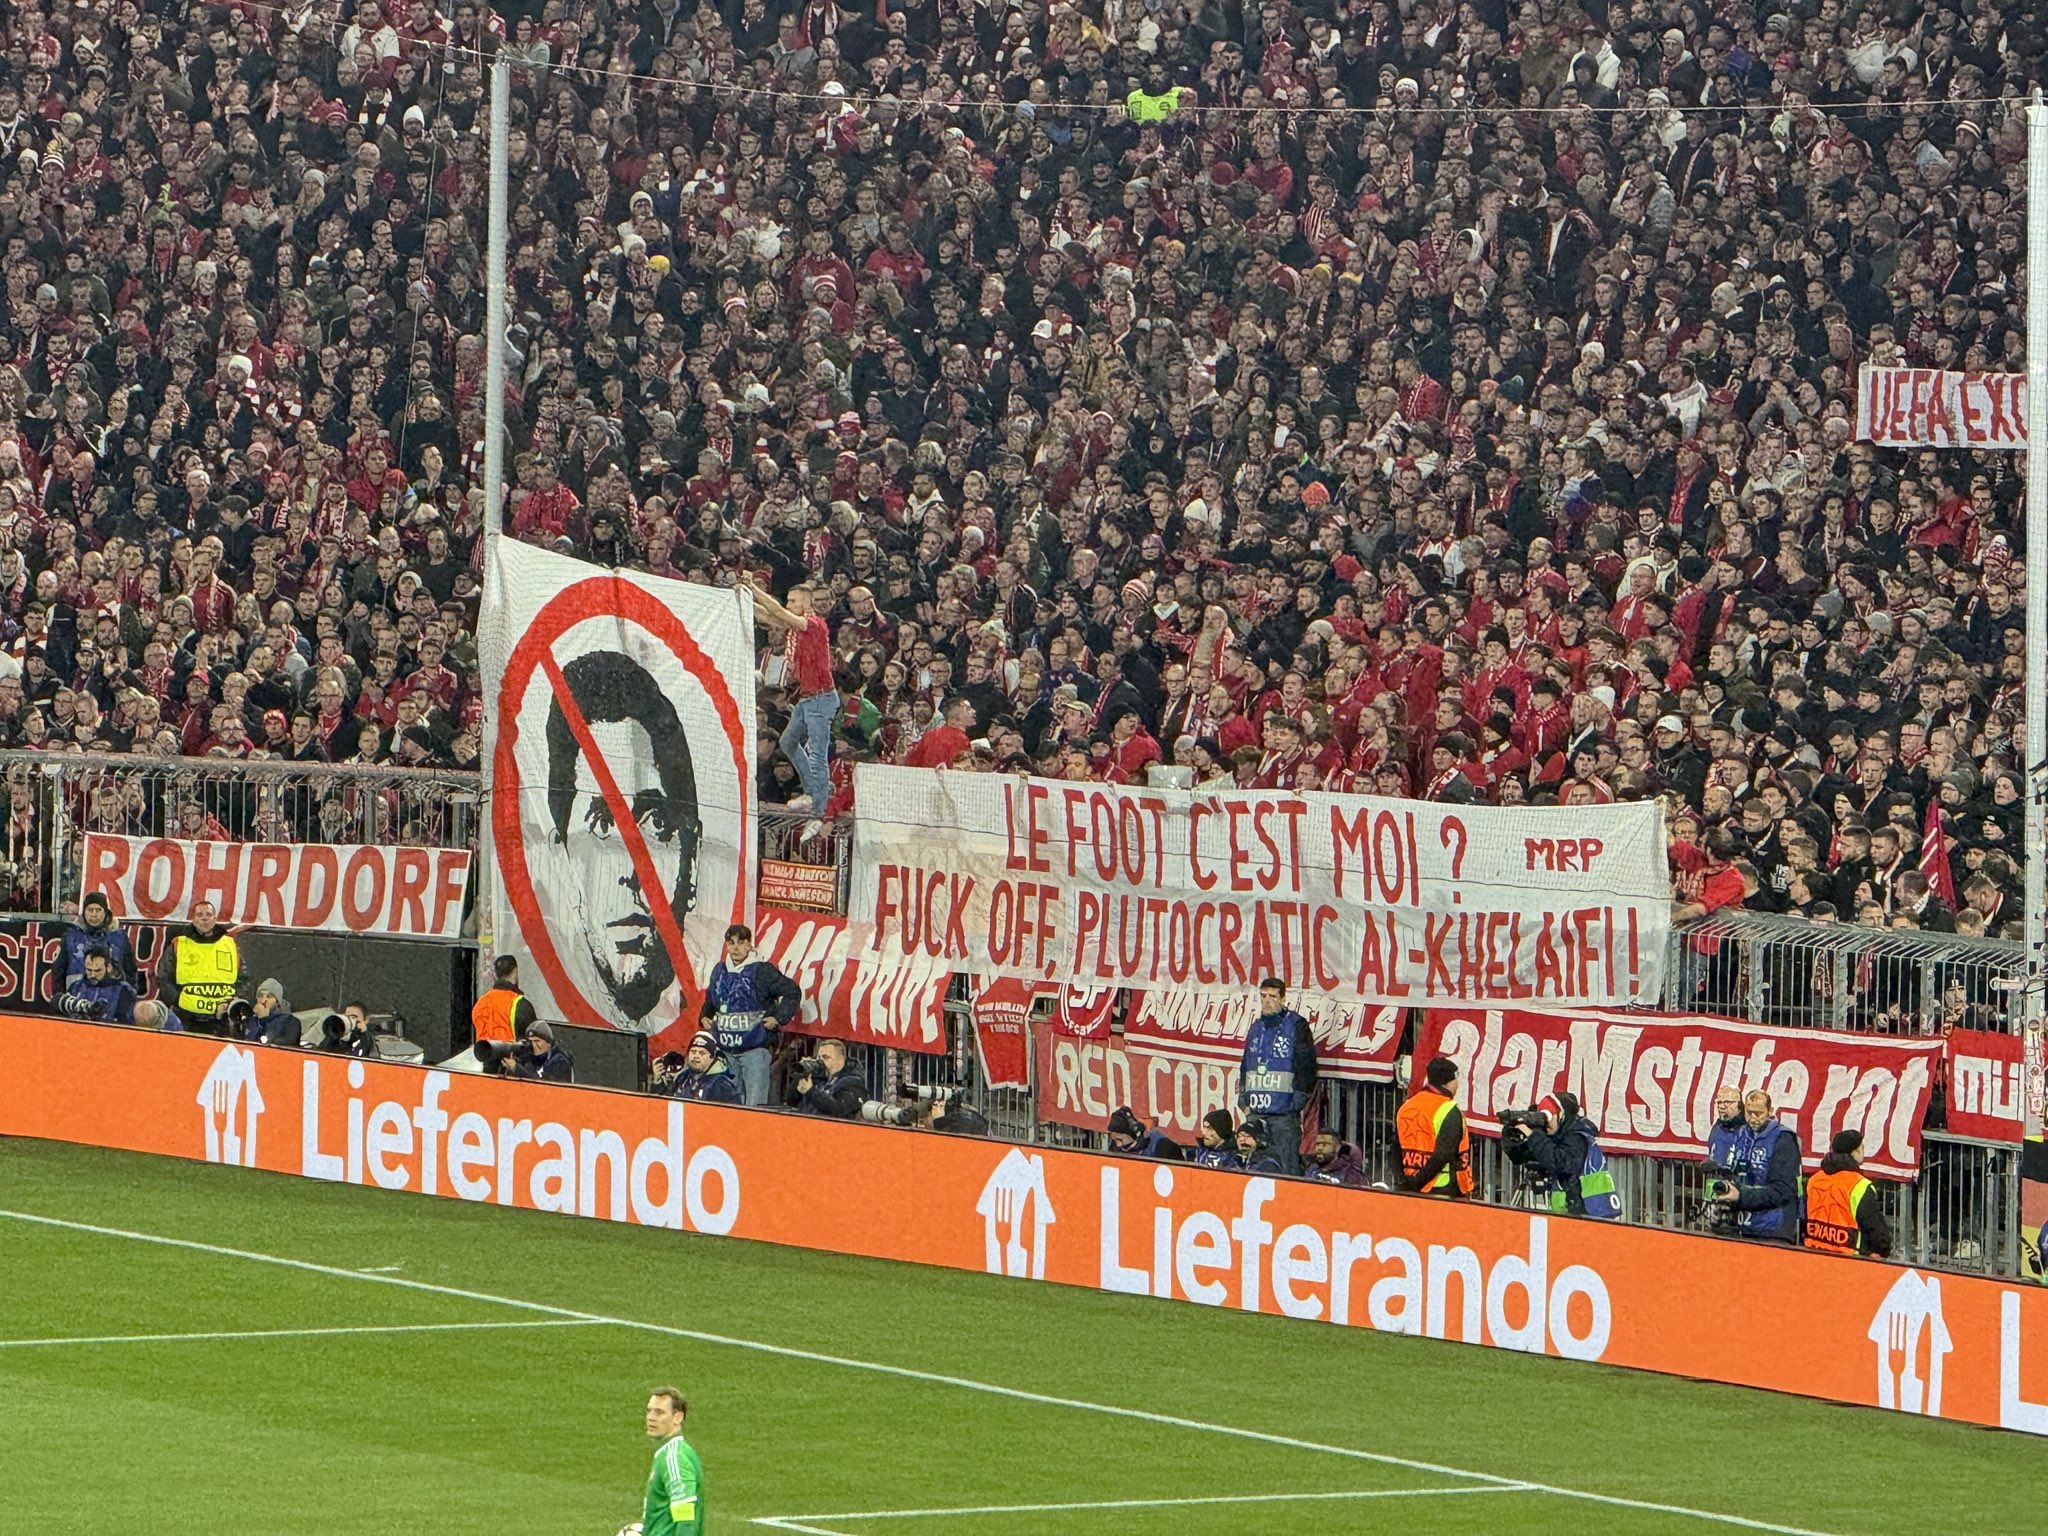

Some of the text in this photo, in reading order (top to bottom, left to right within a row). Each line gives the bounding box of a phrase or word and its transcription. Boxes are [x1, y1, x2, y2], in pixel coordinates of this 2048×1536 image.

[1869, 371, 1958, 446] UEFA
[84, 836, 469, 935] ROHRDORF
[1004, 783, 1468, 907] LE FOOT C'EST MOI ?
[1525, 837, 1604, 873] MRP
[872, 864, 975, 960] FUCK
[987, 878, 1060, 981] OFF,
[1073, 891, 1340, 992] PLUTOCRATIC
[1357, 906, 1640, 1000] AL-KHELAIFI!
[1056, 1041, 1132, 1117] RED
[1250, 1093, 1272, 1109] 030
[1811, 1056, 1929, 1164] rot
[303, 1060, 740, 1236] Lieferando
[1101, 1165, 1612, 1362] Lieferando
